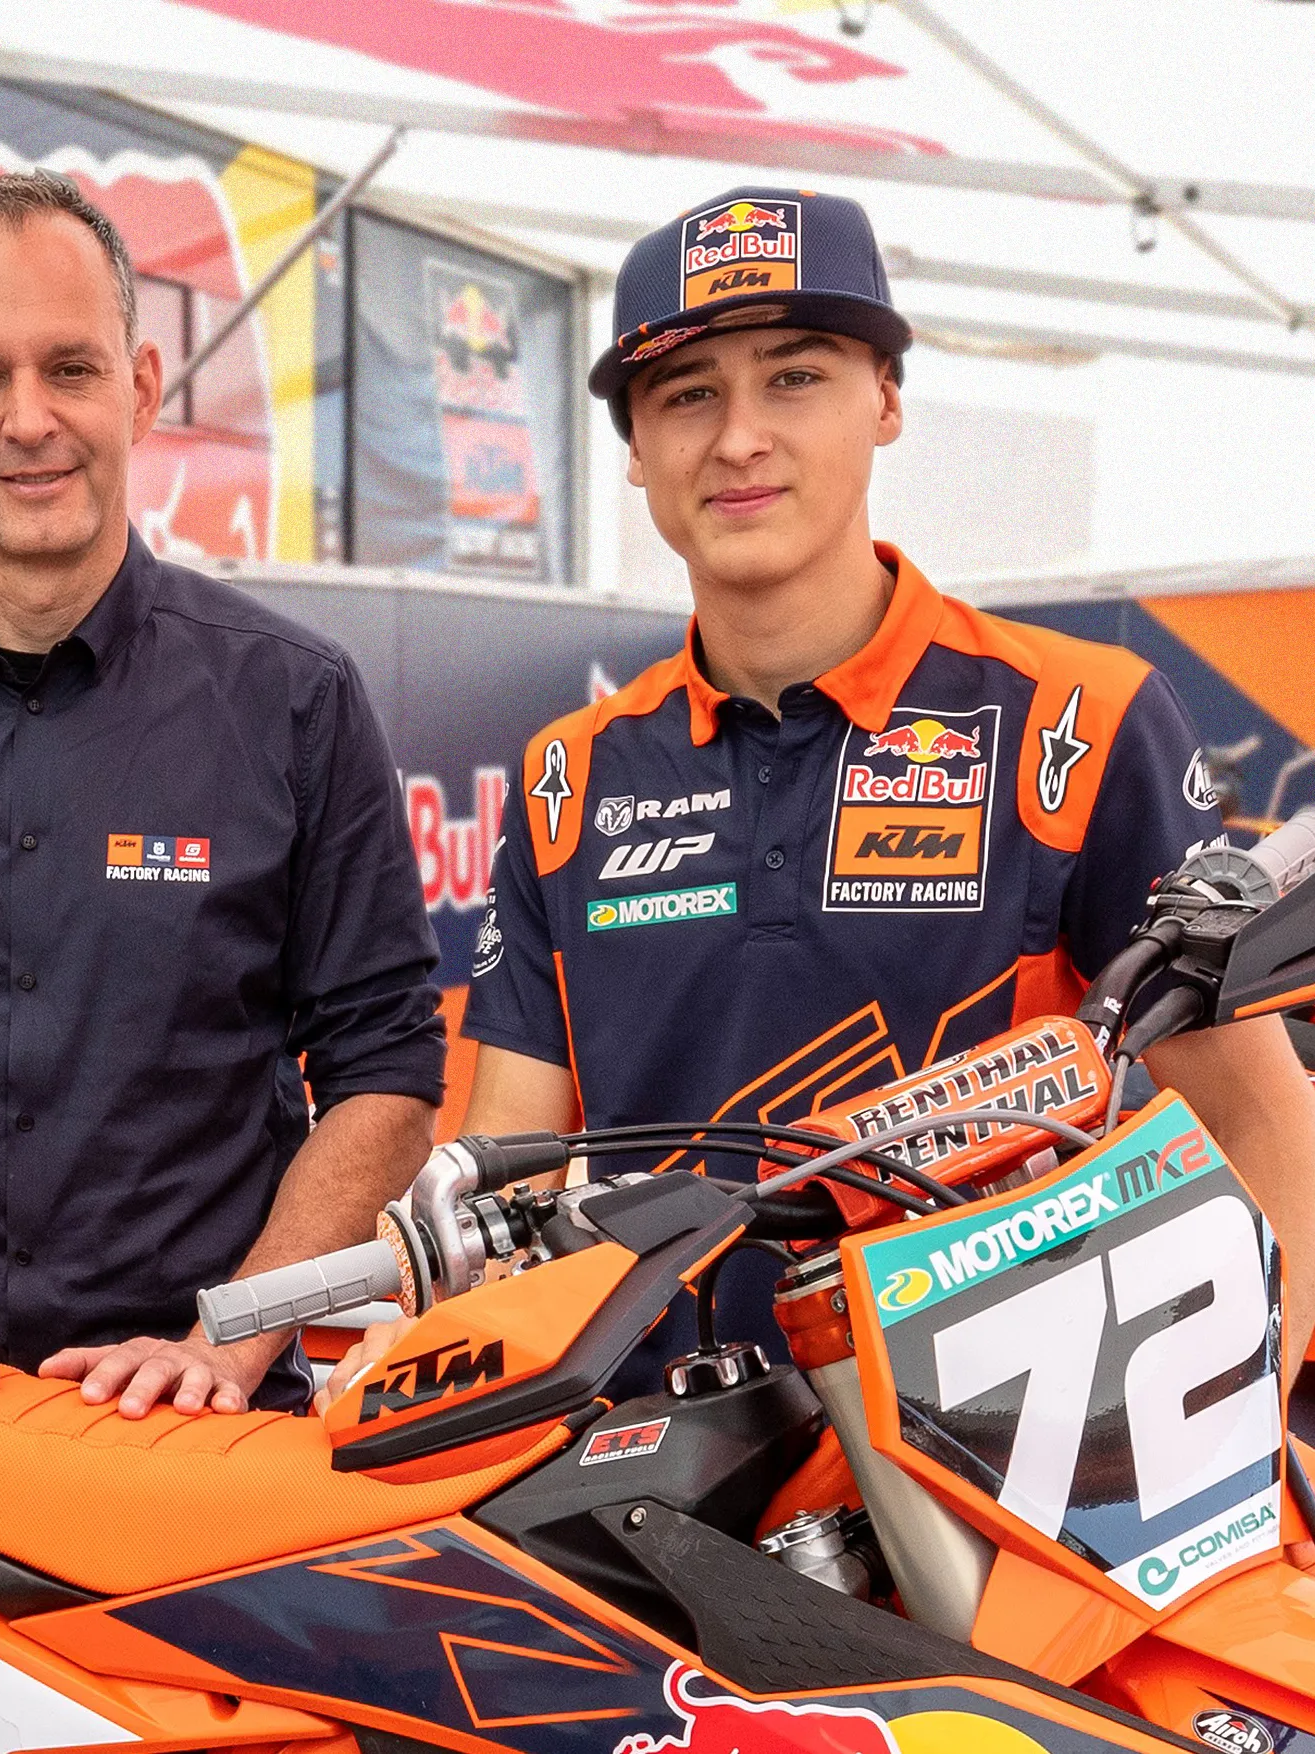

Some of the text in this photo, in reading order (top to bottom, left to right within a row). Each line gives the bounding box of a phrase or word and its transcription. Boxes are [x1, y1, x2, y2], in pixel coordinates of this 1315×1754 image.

[687, 234, 793, 271] Red Bull
[708, 268, 771, 295] KTM
[846, 764, 986, 801] Red Bull
[637, 789, 731, 820] RAM
[598, 832, 716, 880] WP
[854, 825, 965, 858] KTM
[106, 865, 210, 882] FACTORY RACING
[831, 881, 978, 902] FACTORY RACING
[619, 887, 732, 924] MOTOREX
[847, 1028, 1079, 1141] RENTHAL
[928, 1128, 1213, 1291] MOTOREX MX2
[358, 1337, 504, 1424] KTM
[933, 1195, 1284, 1545] 72
[589, 1422, 665, 1455] ETS
[1178, 1505, 1277, 1567] COMISA
[1197, 1713, 1261, 1753] Airoh
